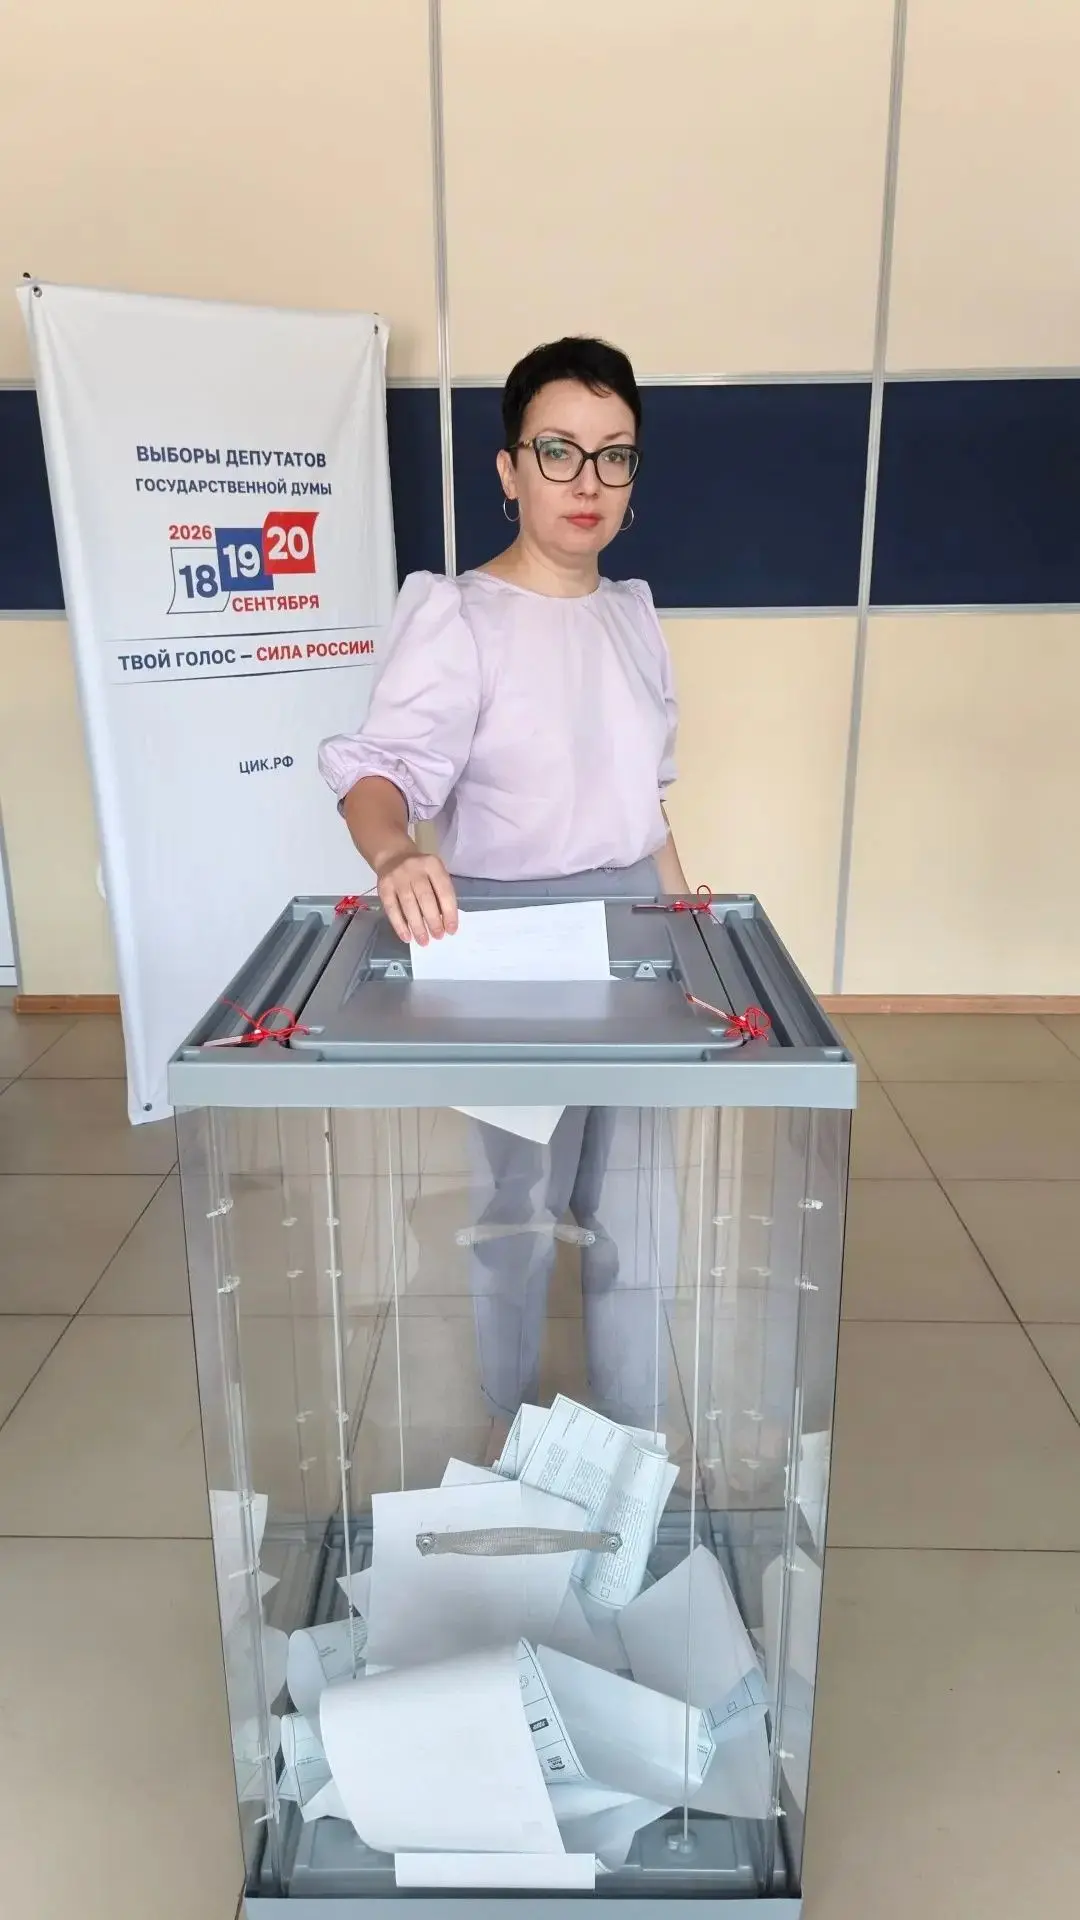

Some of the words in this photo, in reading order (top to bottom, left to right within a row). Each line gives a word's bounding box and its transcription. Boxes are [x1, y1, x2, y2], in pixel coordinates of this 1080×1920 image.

[135, 445, 221, 465] ВЫБОРЫ
[225, 449, 327, 468] ДЕПУТАТОВ
[135, 477, 287, 495] ГОСУДАРСТВЕННОЙ
[291, 482, 332, 497] ДУМЫ
[168, 524, 213, 541] 2026
[178, 564, 219, 599] 18
[222, 543, 261, 578] 19
[266, 525, 310, 561] 20
[231, 594, 320, 613] СЕНТЯБРЯ
[117, 648, 171, 671] ТВОЙ
[175, 648, 236, 667] ГОЛОС
[256, 644, 303, 662] СИЛА
[306, 639, 374, 658] РОССИИ!
[239, 755, 294, 775] ЦИК.РФ
